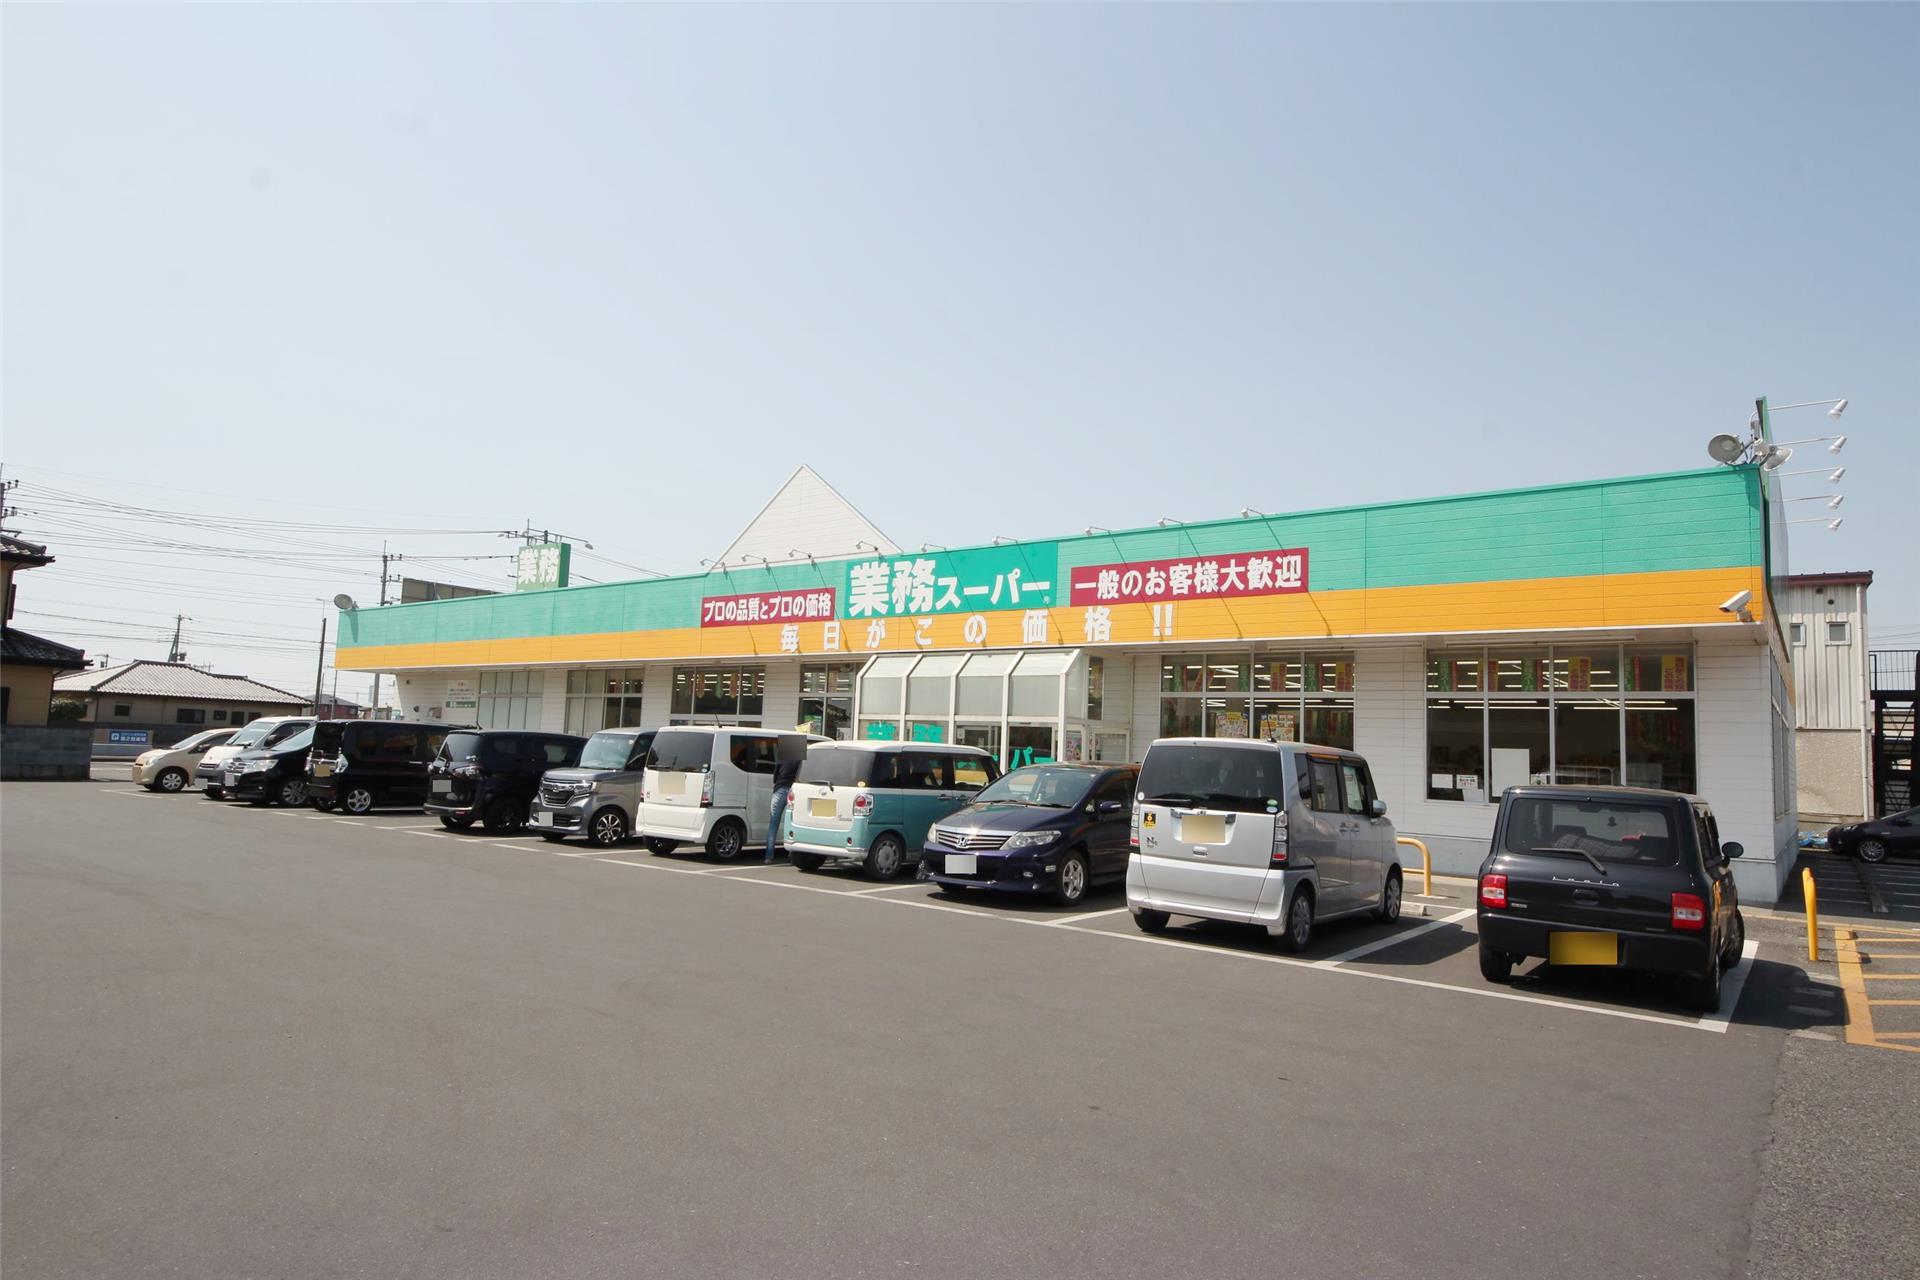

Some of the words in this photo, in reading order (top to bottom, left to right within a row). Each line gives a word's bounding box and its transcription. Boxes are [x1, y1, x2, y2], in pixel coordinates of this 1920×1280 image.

[518, 547, 559, 584] 業務
[1075, 555, 1302, 600] 一般のお客様大歓迎
[704, 593, 832, 623] プロの品質とプロの価格
[849, 558, 1050, 617] 業務スーパー
